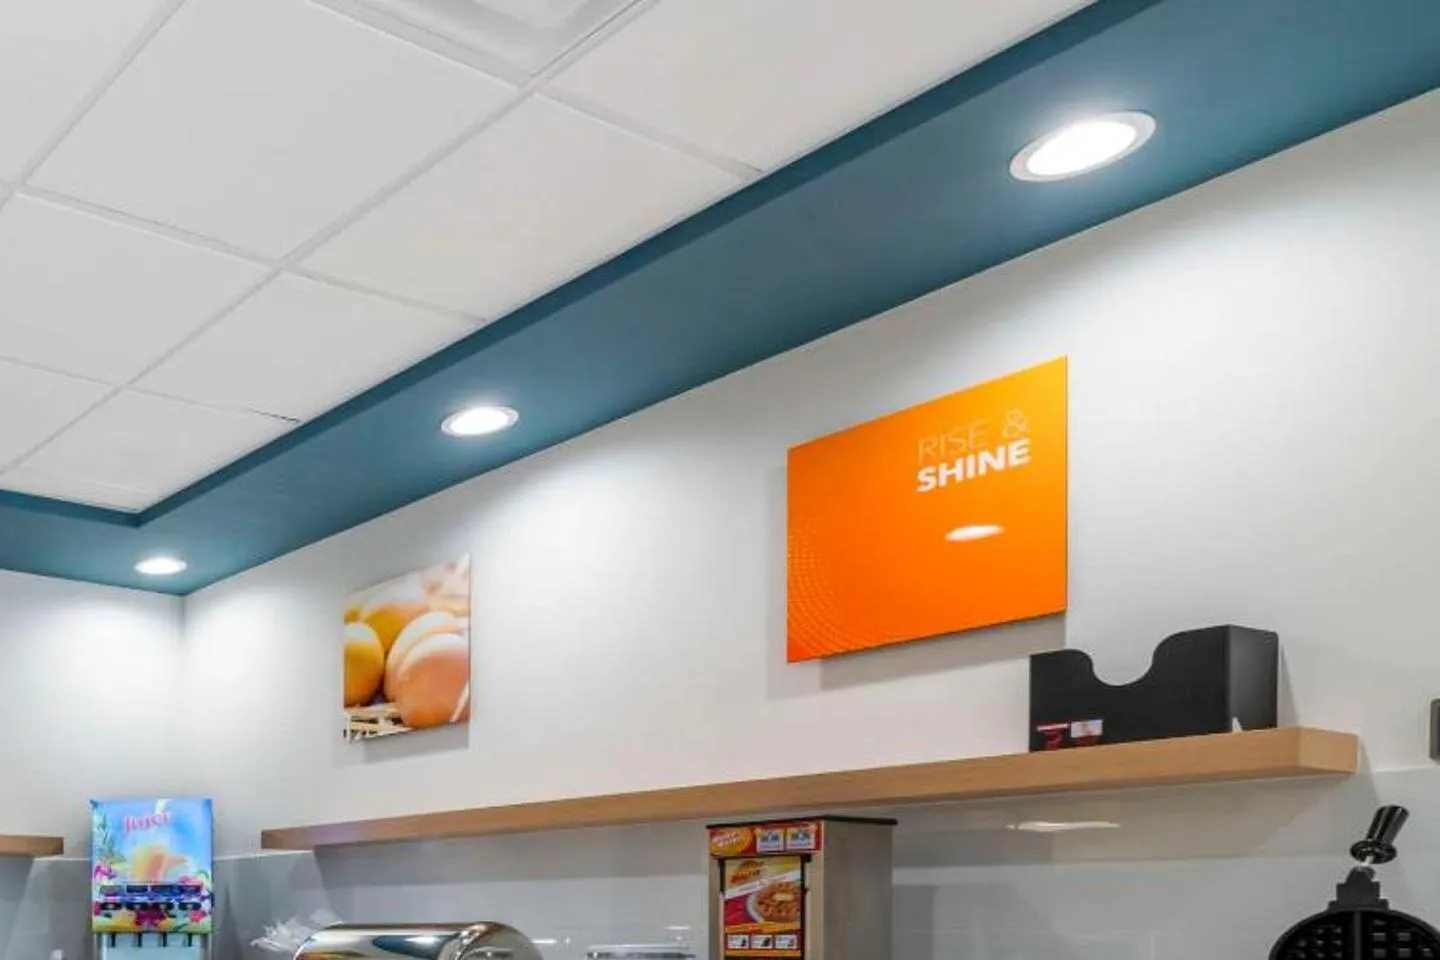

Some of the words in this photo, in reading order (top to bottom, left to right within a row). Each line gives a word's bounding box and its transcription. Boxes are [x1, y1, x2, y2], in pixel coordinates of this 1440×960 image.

[918, 419, 988, 464] RISE
[1001, 410, 1028, 440] &
[916, 438, 1032, 492] SHINE
